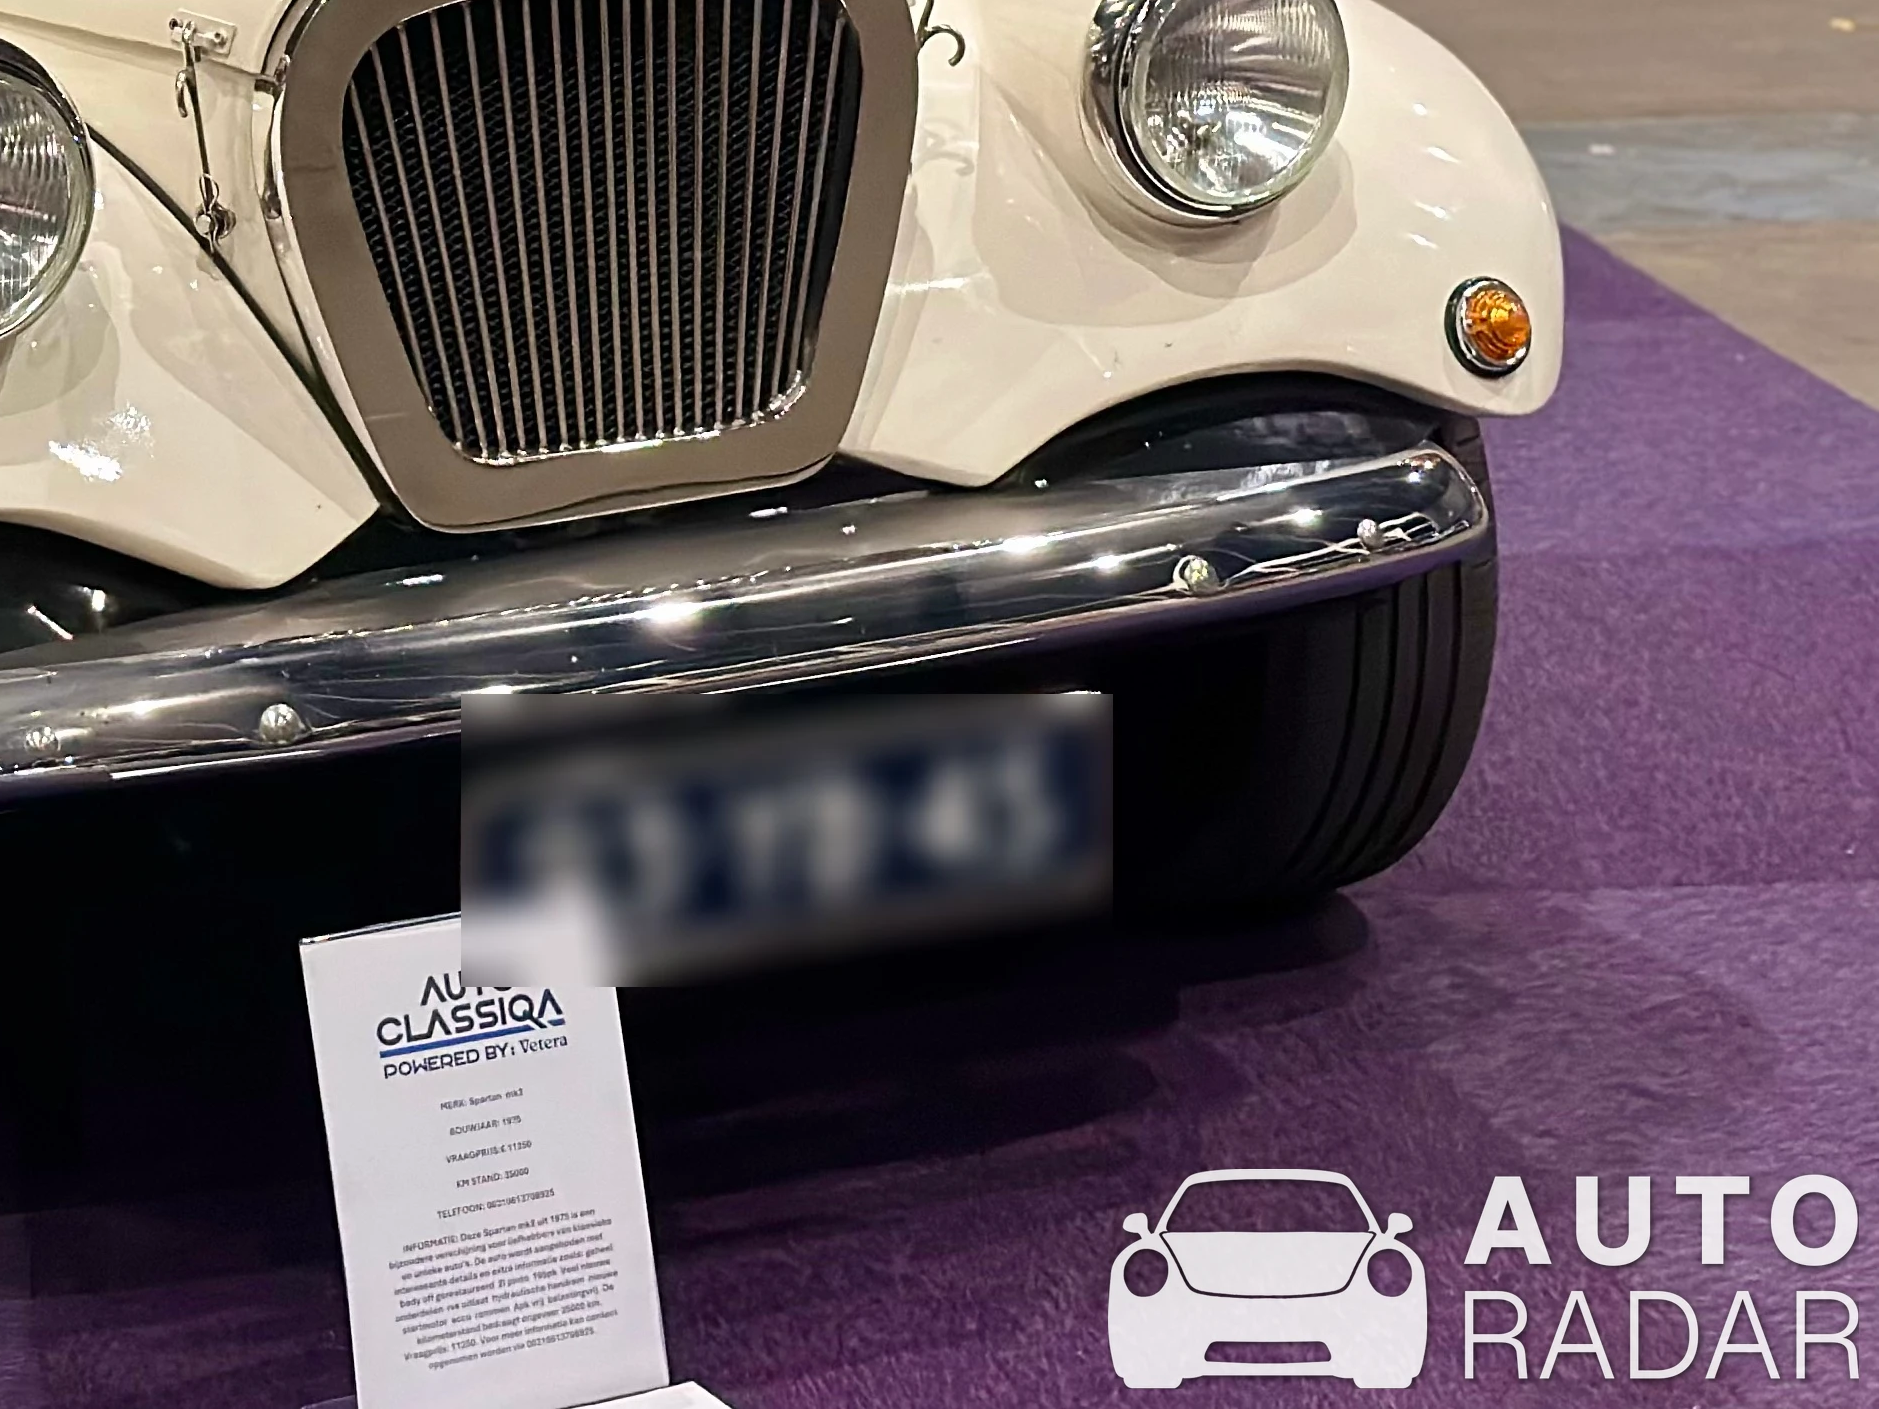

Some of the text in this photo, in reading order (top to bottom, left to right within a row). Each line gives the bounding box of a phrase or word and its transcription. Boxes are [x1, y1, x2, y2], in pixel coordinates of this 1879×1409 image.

[420, 971, 512, 1006] AU
[384, 1035, 568, 1079] POWERED BY: Vetera
